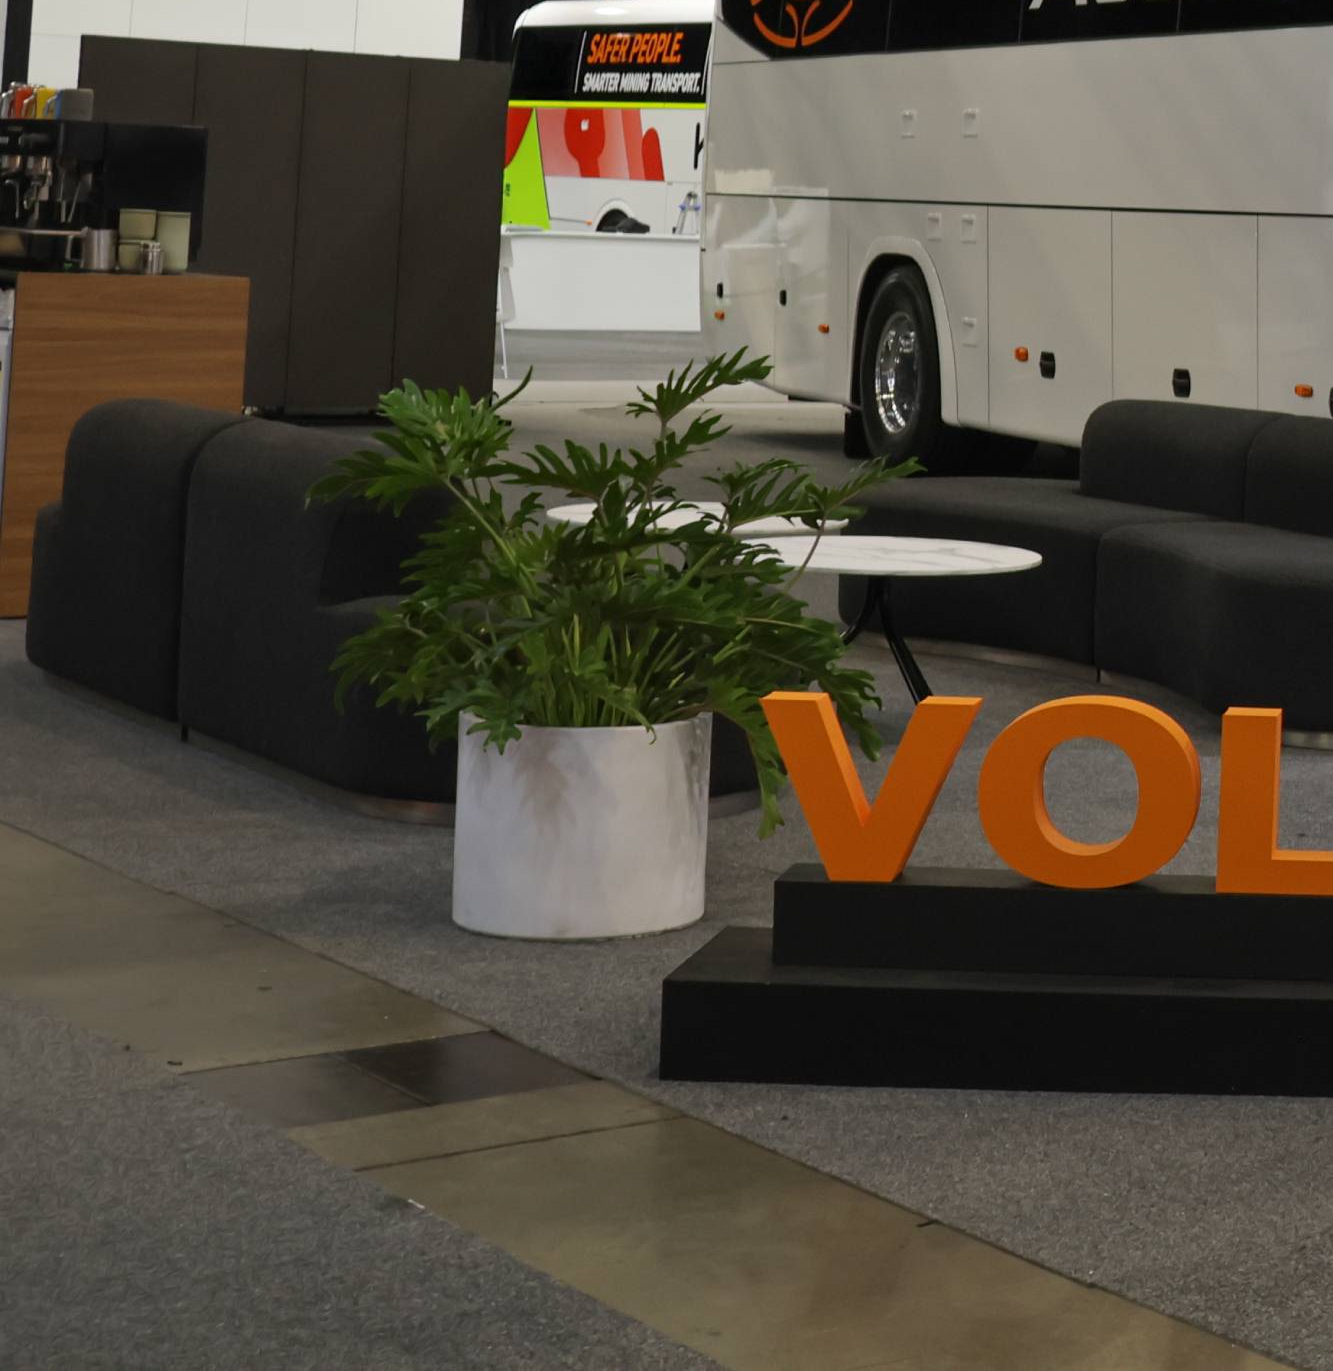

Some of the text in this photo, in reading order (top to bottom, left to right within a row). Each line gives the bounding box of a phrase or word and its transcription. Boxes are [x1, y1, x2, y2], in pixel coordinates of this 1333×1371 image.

[587, 31, 684, 64] SAFER PEOPLE.
[582, 73, 701, 93] SMARTER MINING TRANSPORT.
